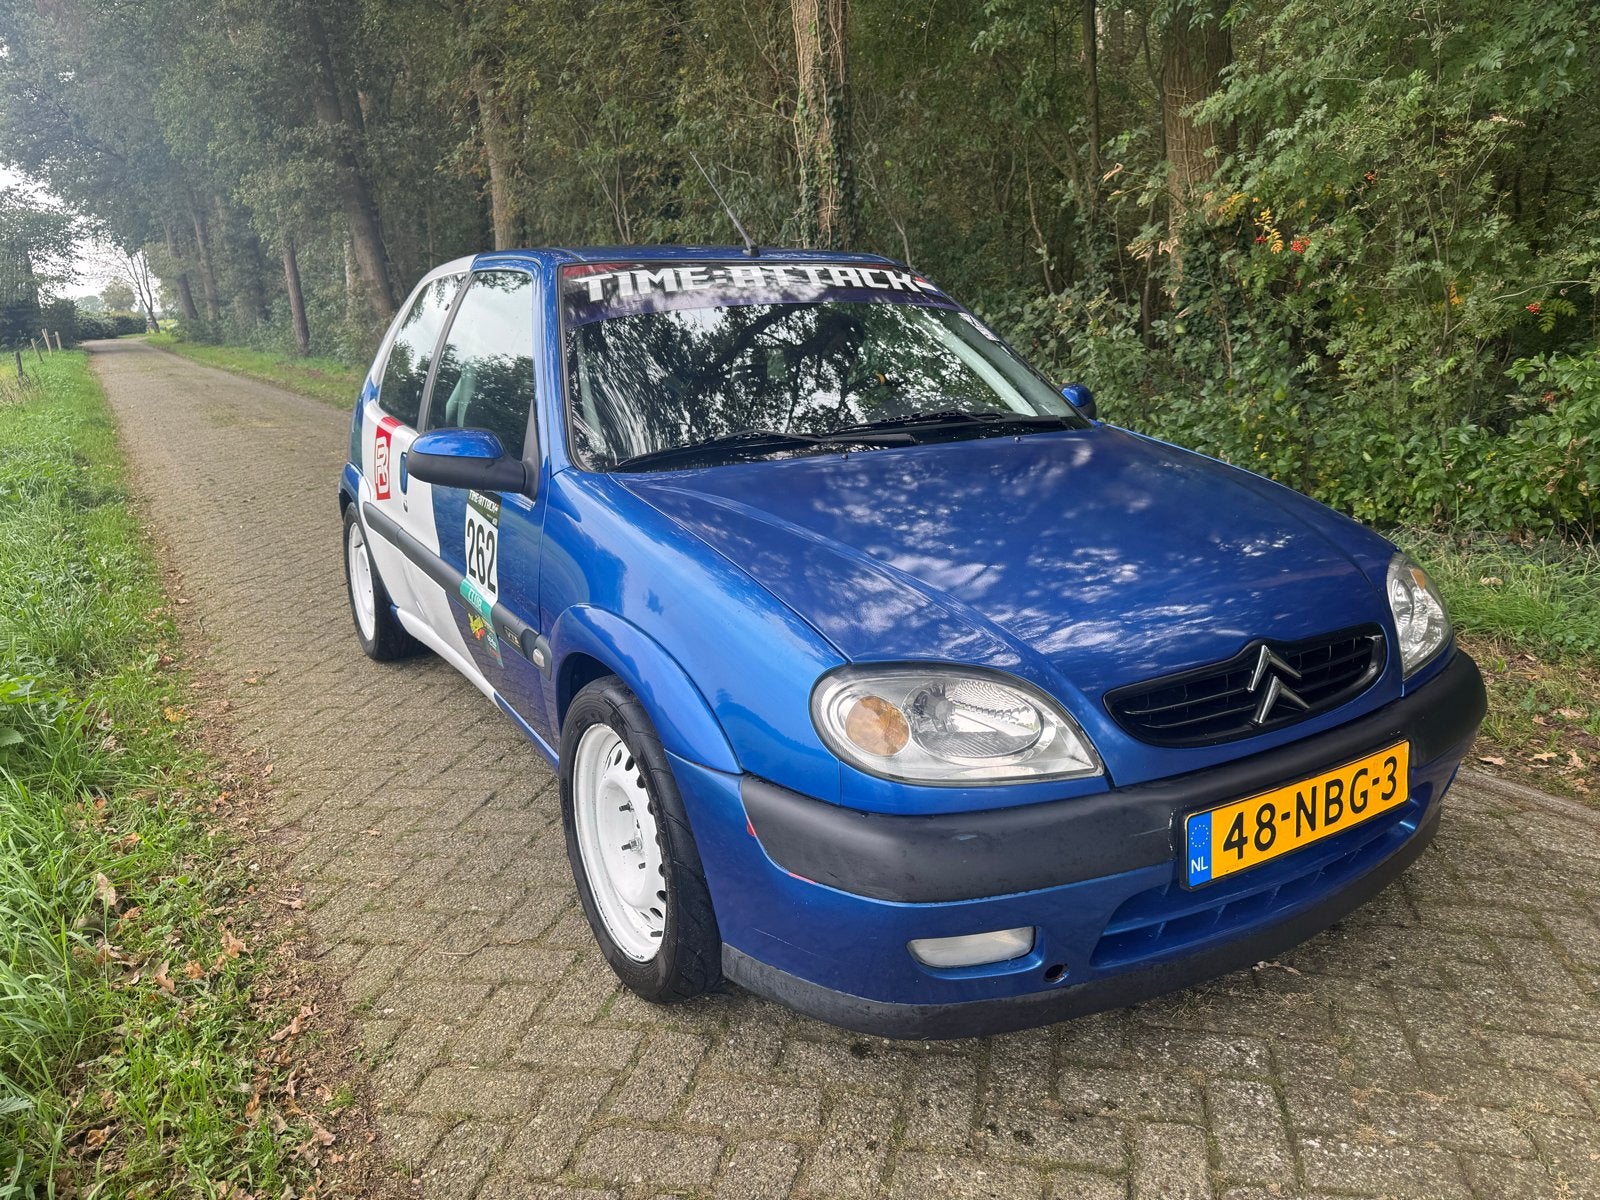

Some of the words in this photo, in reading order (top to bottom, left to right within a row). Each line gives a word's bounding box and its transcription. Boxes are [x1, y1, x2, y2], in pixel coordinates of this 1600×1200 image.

[467, 518, 496, 594] 262
[1222, 756, 1398, 860] 48-NBG-3
[1191, 856, 1209, 874] NL
